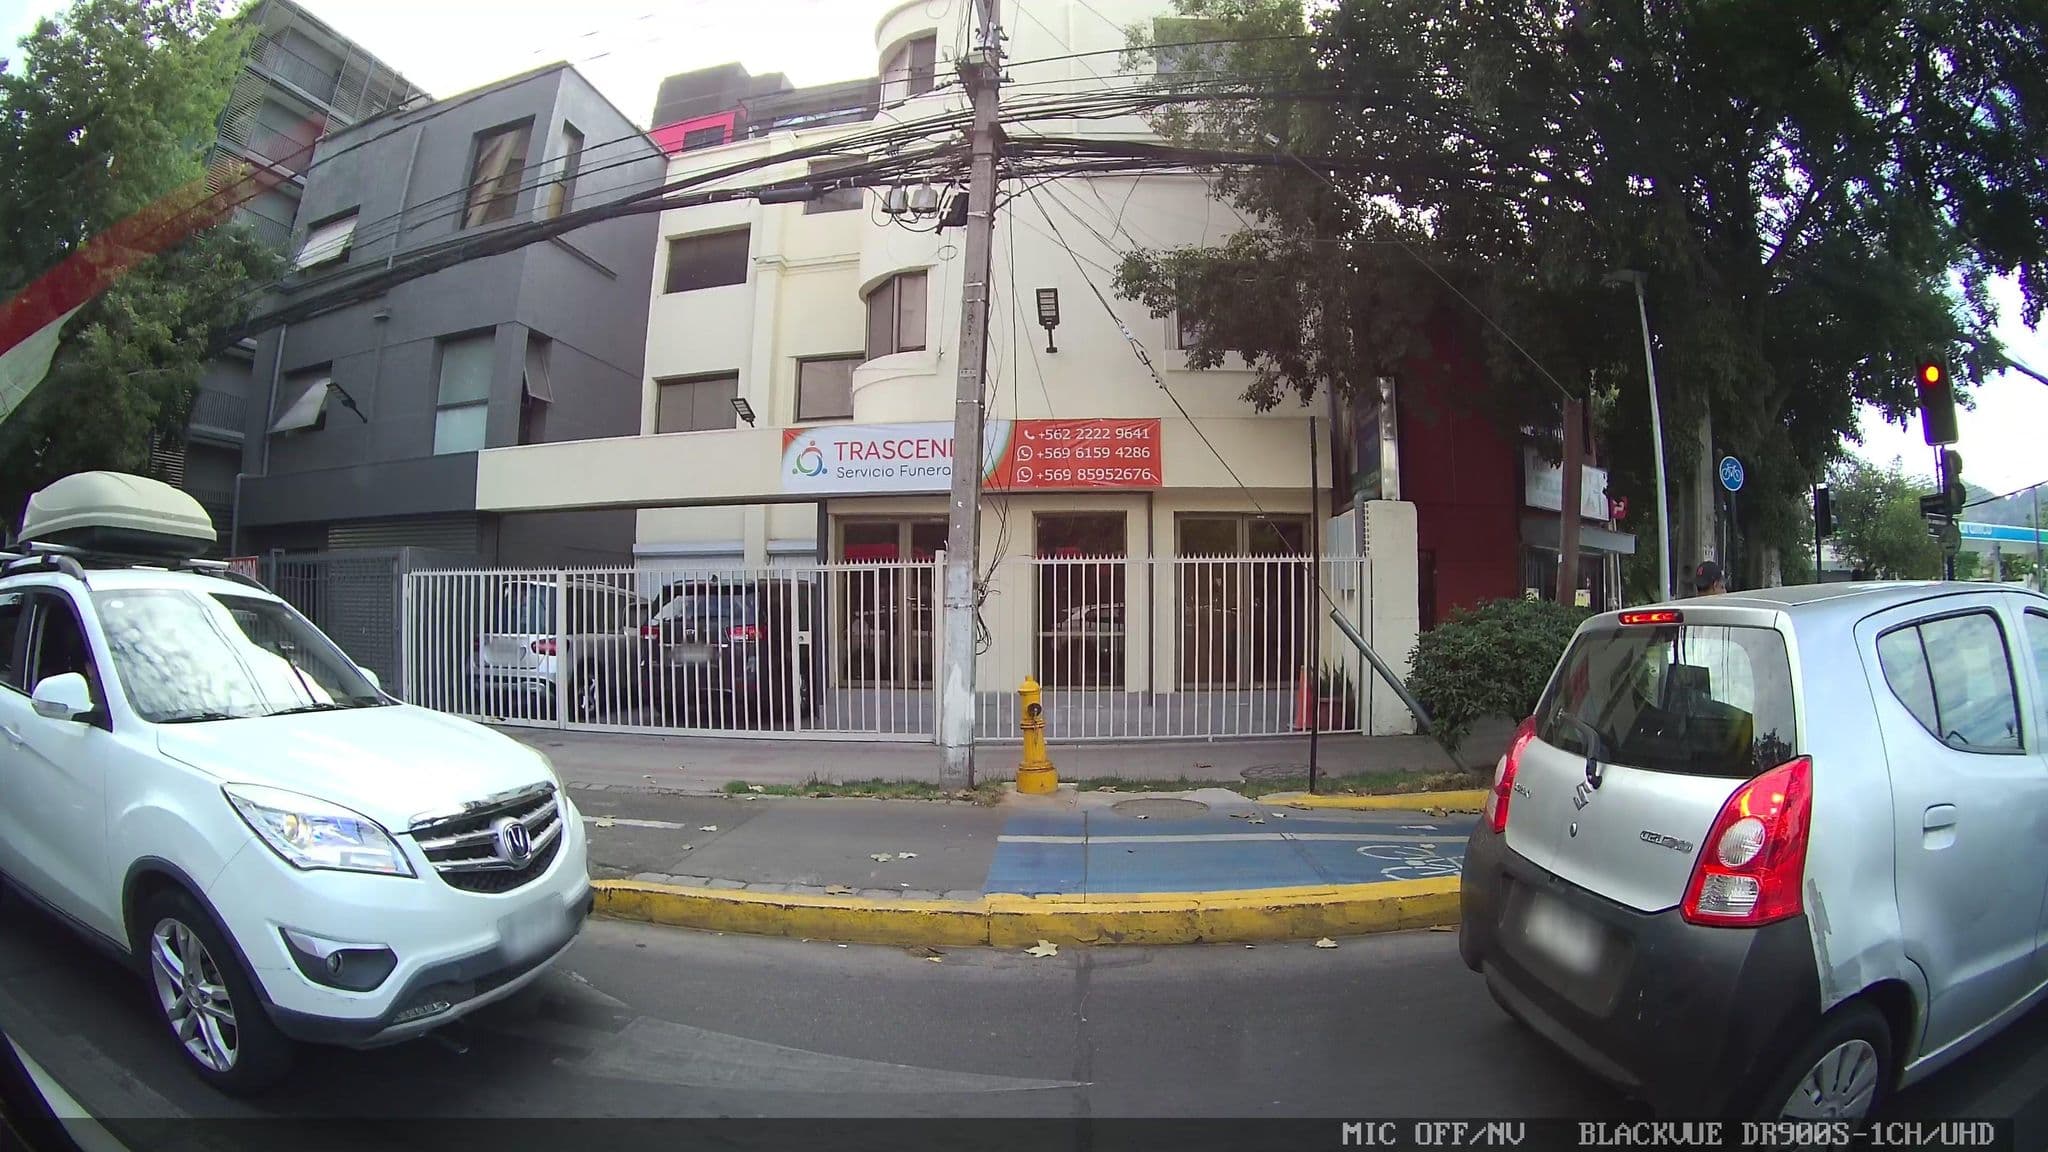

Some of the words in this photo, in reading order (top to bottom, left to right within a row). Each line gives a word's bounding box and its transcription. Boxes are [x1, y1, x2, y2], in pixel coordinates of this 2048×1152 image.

[1038, 428, 1071, 440] +562
[1075, 428, 1111, 440] 2222
[1115, 428, 1150, 439] 9641
[1037, 447, 1071, 459] +569
[1075, 447, 1111, 459] 6159
[1115, 446, 1151, 459] 4286
[836, 465, 895, 479] Servicio
[1036, 469, 1072, 481] +569
[1077, 468, 1152, 481] 85952676
